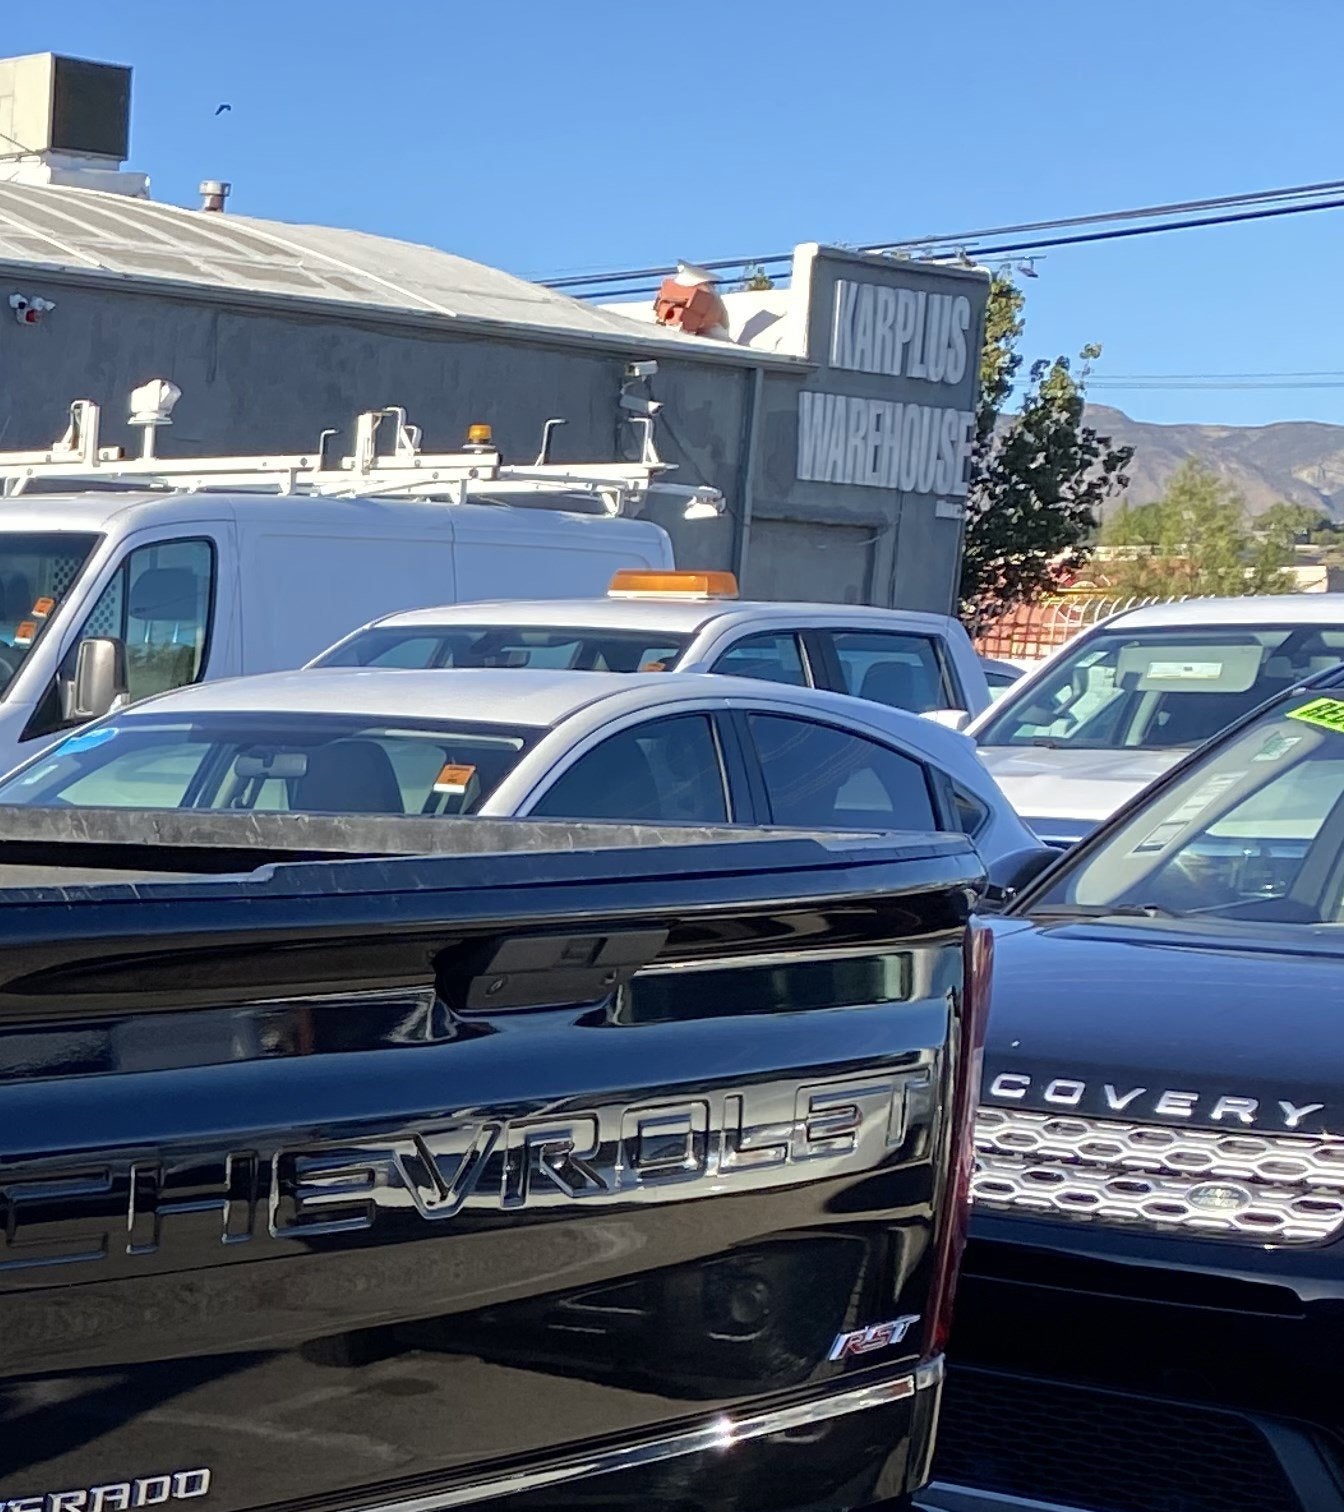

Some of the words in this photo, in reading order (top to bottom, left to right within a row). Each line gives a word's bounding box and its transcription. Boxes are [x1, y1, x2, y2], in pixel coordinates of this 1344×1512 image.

[829, 279, 971, 385] KARPLUS
[797, 391, 975, 497] WAREHOUSE
[990, 1072, 1326, 1128] COVERY
[827, 1314, 921, 1361] RST
